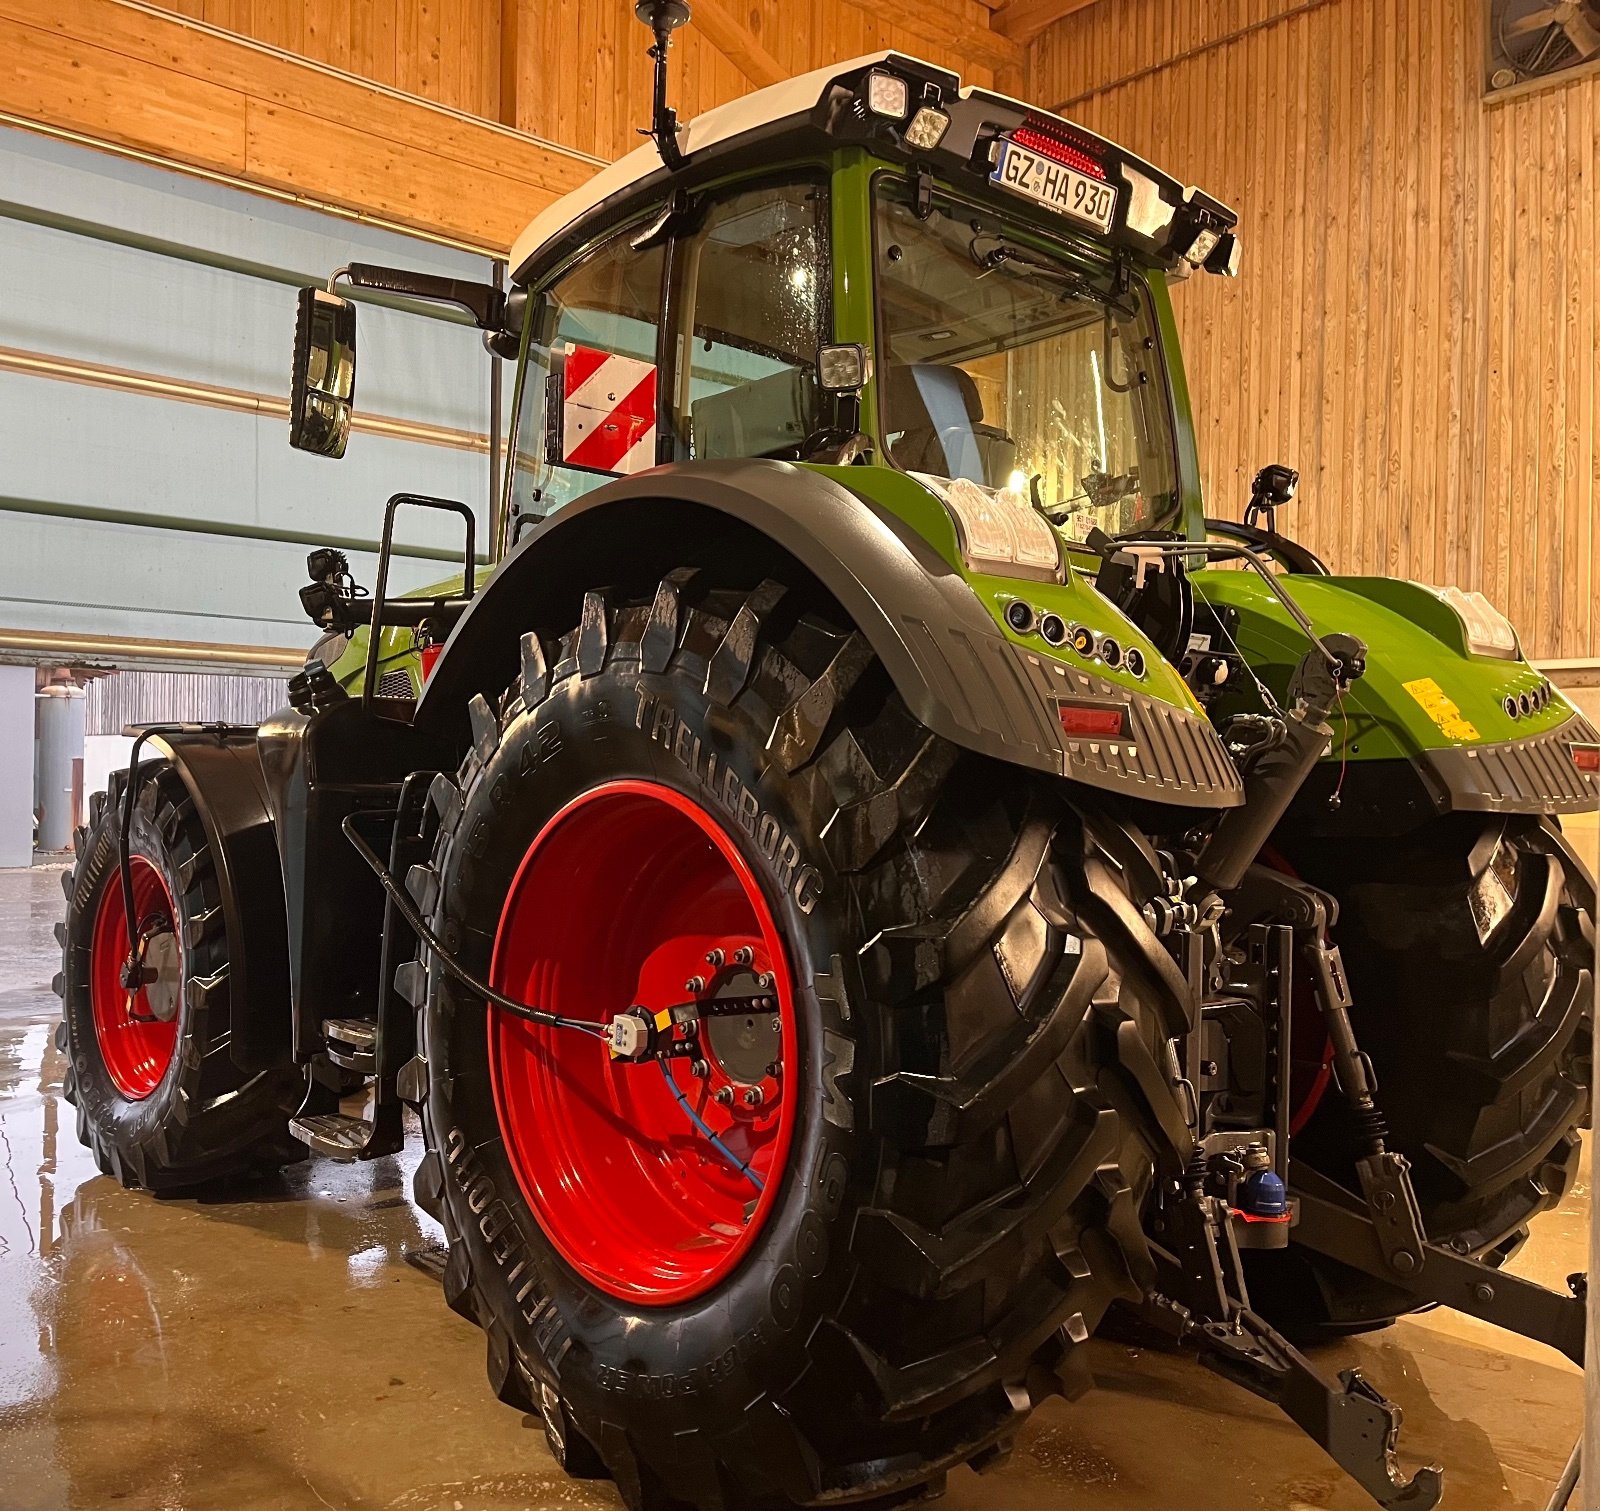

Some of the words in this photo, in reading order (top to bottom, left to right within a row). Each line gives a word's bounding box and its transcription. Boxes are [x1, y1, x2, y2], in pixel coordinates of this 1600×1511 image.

[1005, 149, 1036, 190] GZ
[1042, 165, 1070, 206] HA
[1073, 180, 1111, 221] 930
[519, 719, 565, 779] 42
[634, 680, 825, 915] TRELLEBORG
[444, 1126, 572, 1381] TRELLEBORG
[597, 1363, 698, 1399] POWER
